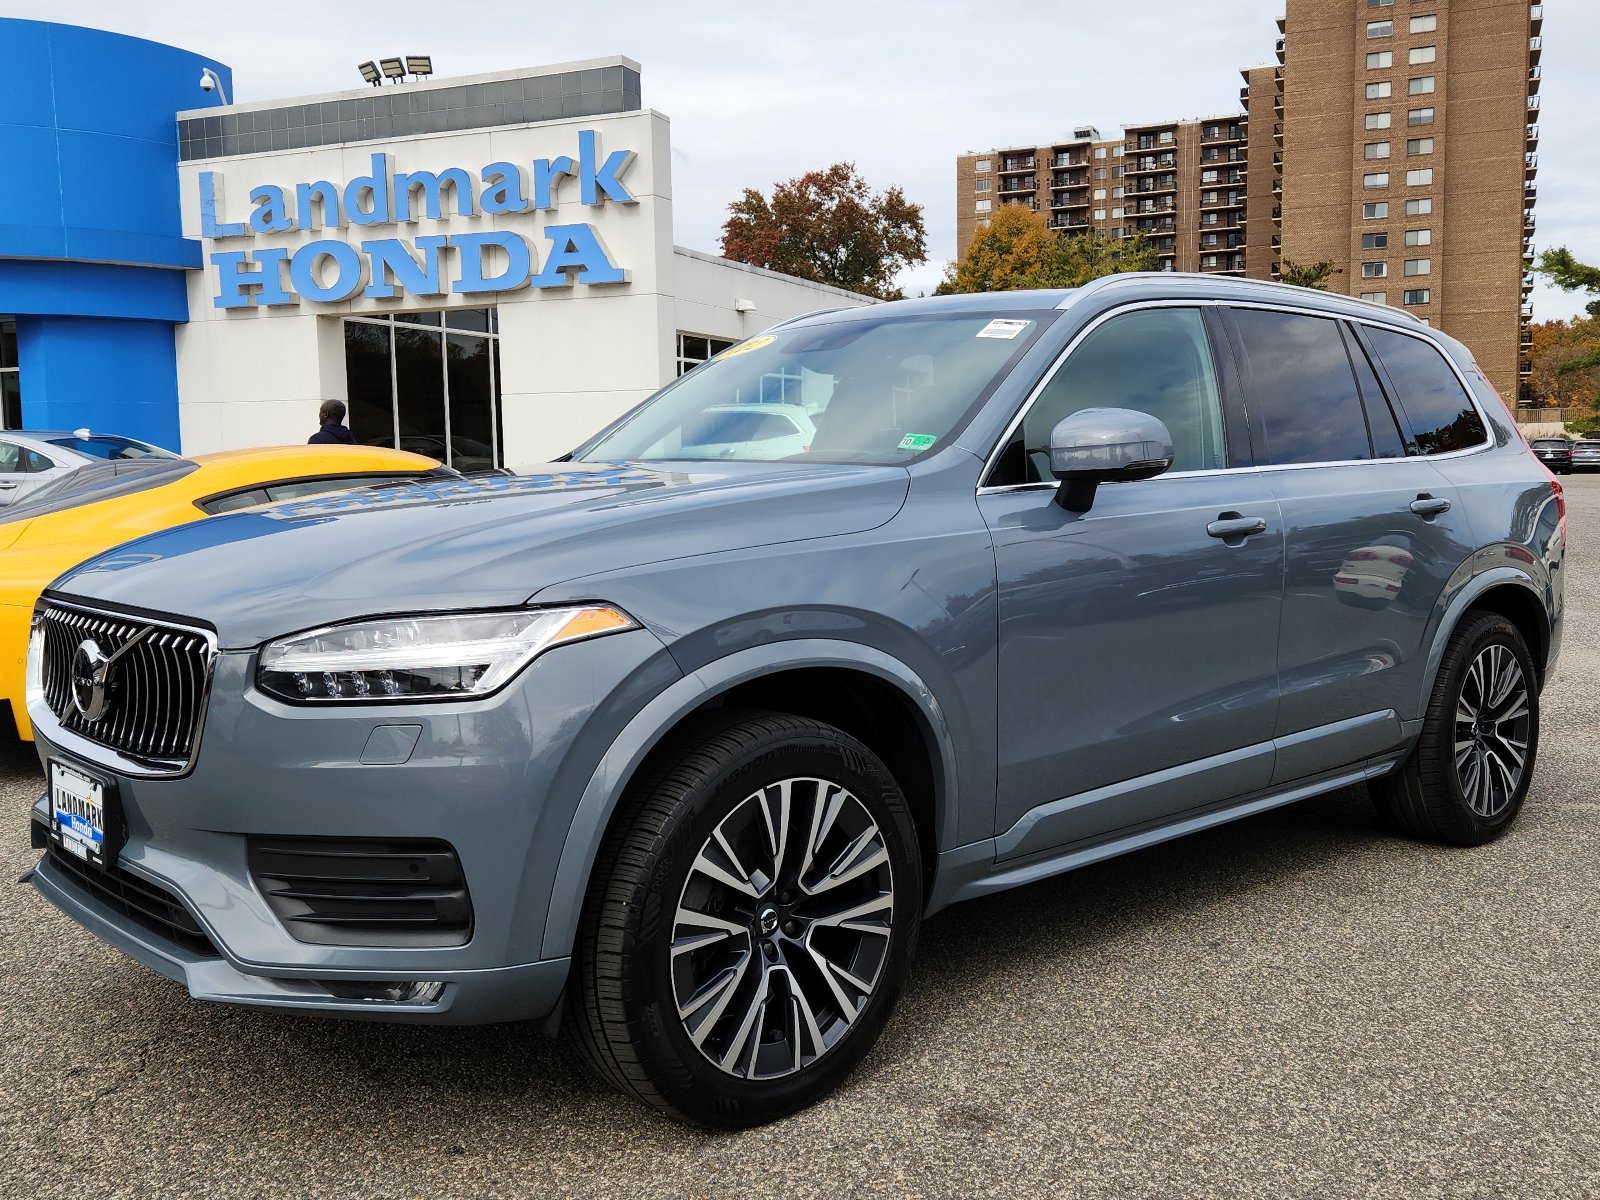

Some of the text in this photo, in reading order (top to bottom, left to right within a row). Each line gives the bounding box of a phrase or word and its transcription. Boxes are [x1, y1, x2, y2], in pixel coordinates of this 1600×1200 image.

[198, 130, 635, 239] Landmark
[211, 223, 630, 308] HONDA
[56, 788, 103, 831] LANDMARK
[71, 816, 93, 838] Honda
